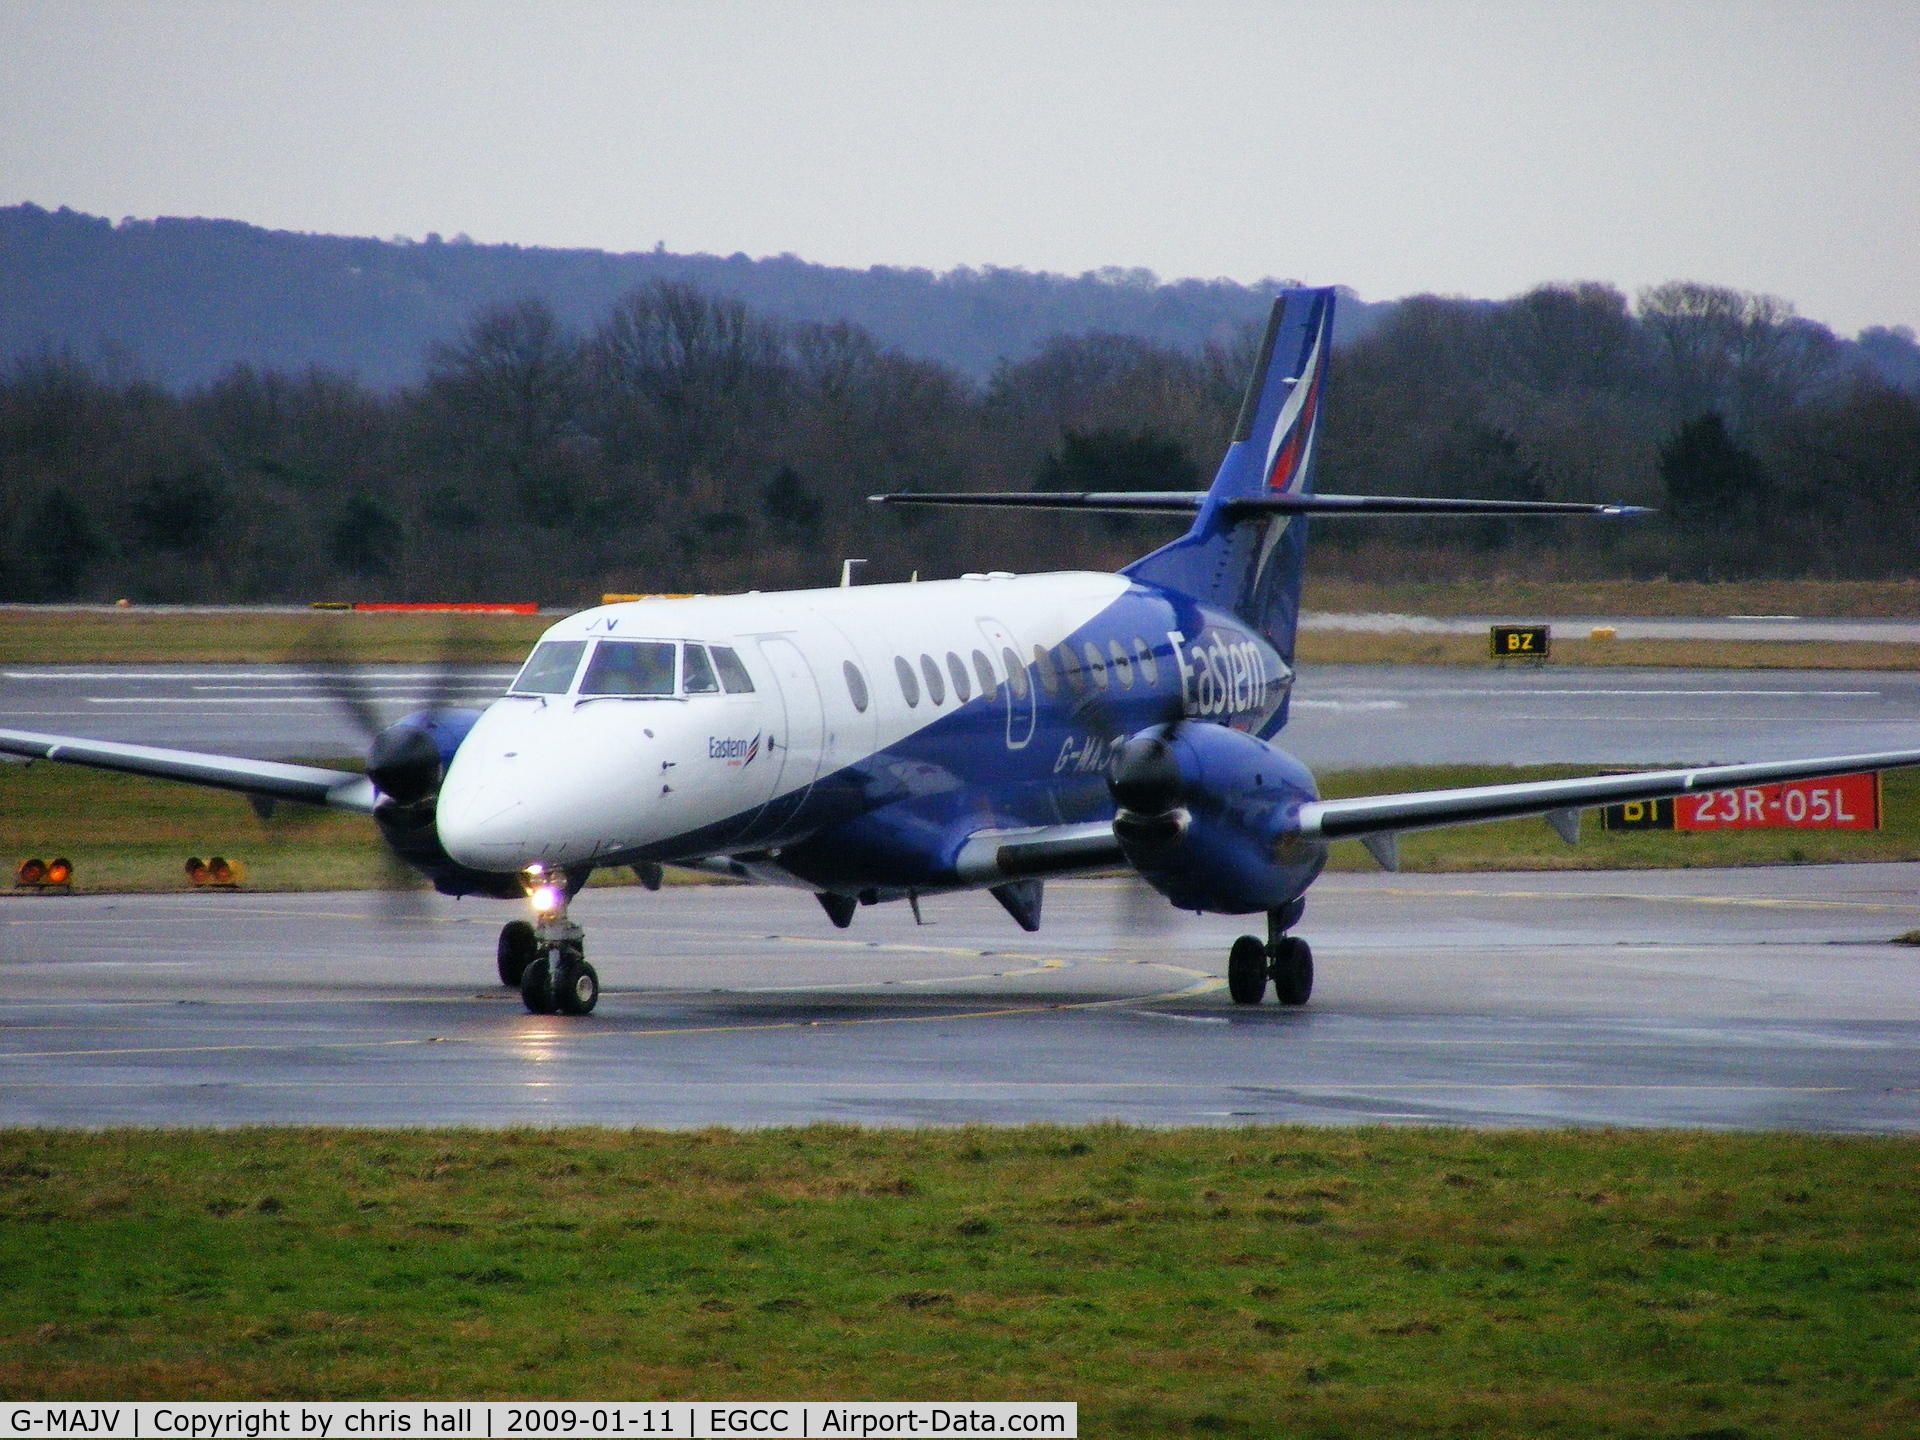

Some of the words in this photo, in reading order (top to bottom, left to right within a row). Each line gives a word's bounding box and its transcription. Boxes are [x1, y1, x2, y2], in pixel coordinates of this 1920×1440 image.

[1167, 630, 1266, 715] Eastern
[709, 736, 747, 758] Eastern
[1053, 734, 1126, 773] G-MAJ
[1695, 788, 1855, 822] 23R-05L
